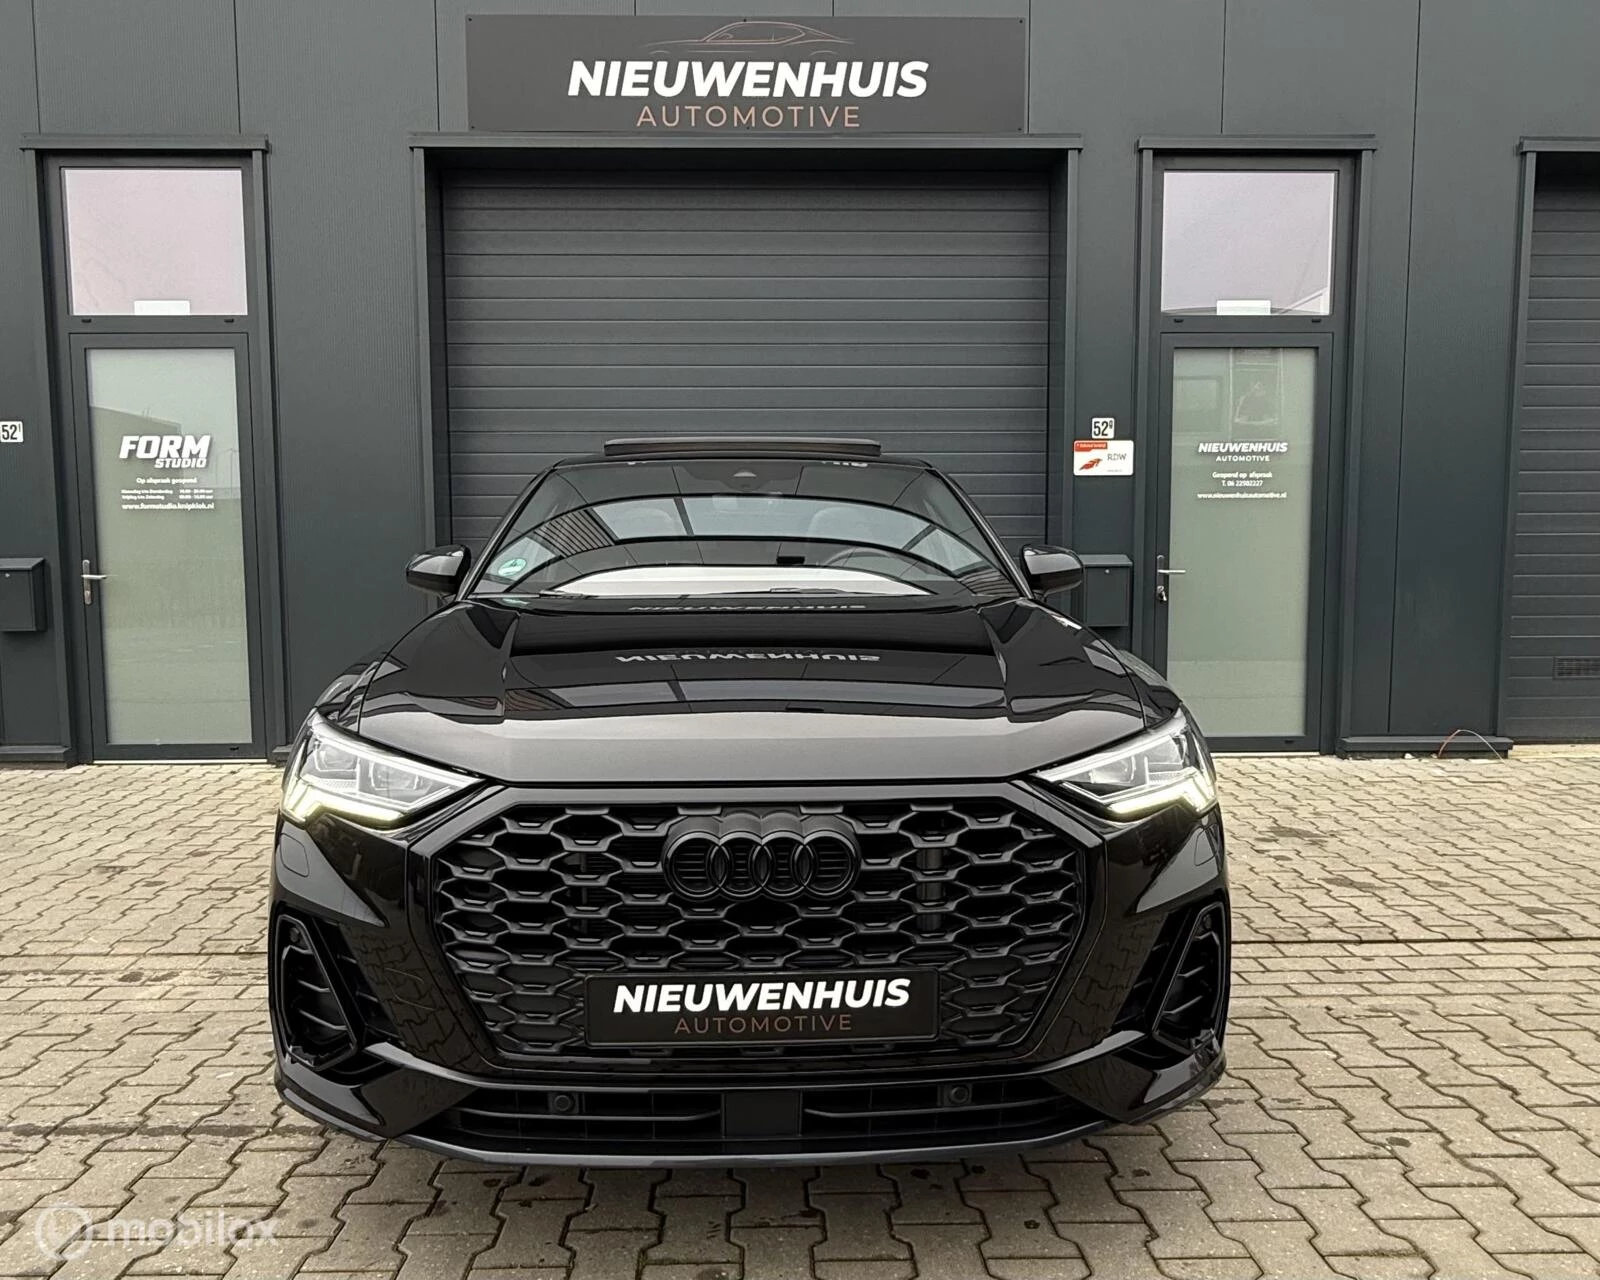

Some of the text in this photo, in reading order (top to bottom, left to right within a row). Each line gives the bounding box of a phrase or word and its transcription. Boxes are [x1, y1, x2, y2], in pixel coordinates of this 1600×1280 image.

[567, 60, 929, 98] NIEUWENHUIS
[636, 105, 861, 128] AUTOMOTIVE
[119, 435, 211, 459] FORM
[1198, 442, 1289, 453] NIEUWENHUIS
[154, 458, 208, 469] STUDIO
[613, 978, 911, 1013] NIEUWENHUIS
[674, 1014, 852, 1035] AUTOMOTIVE
